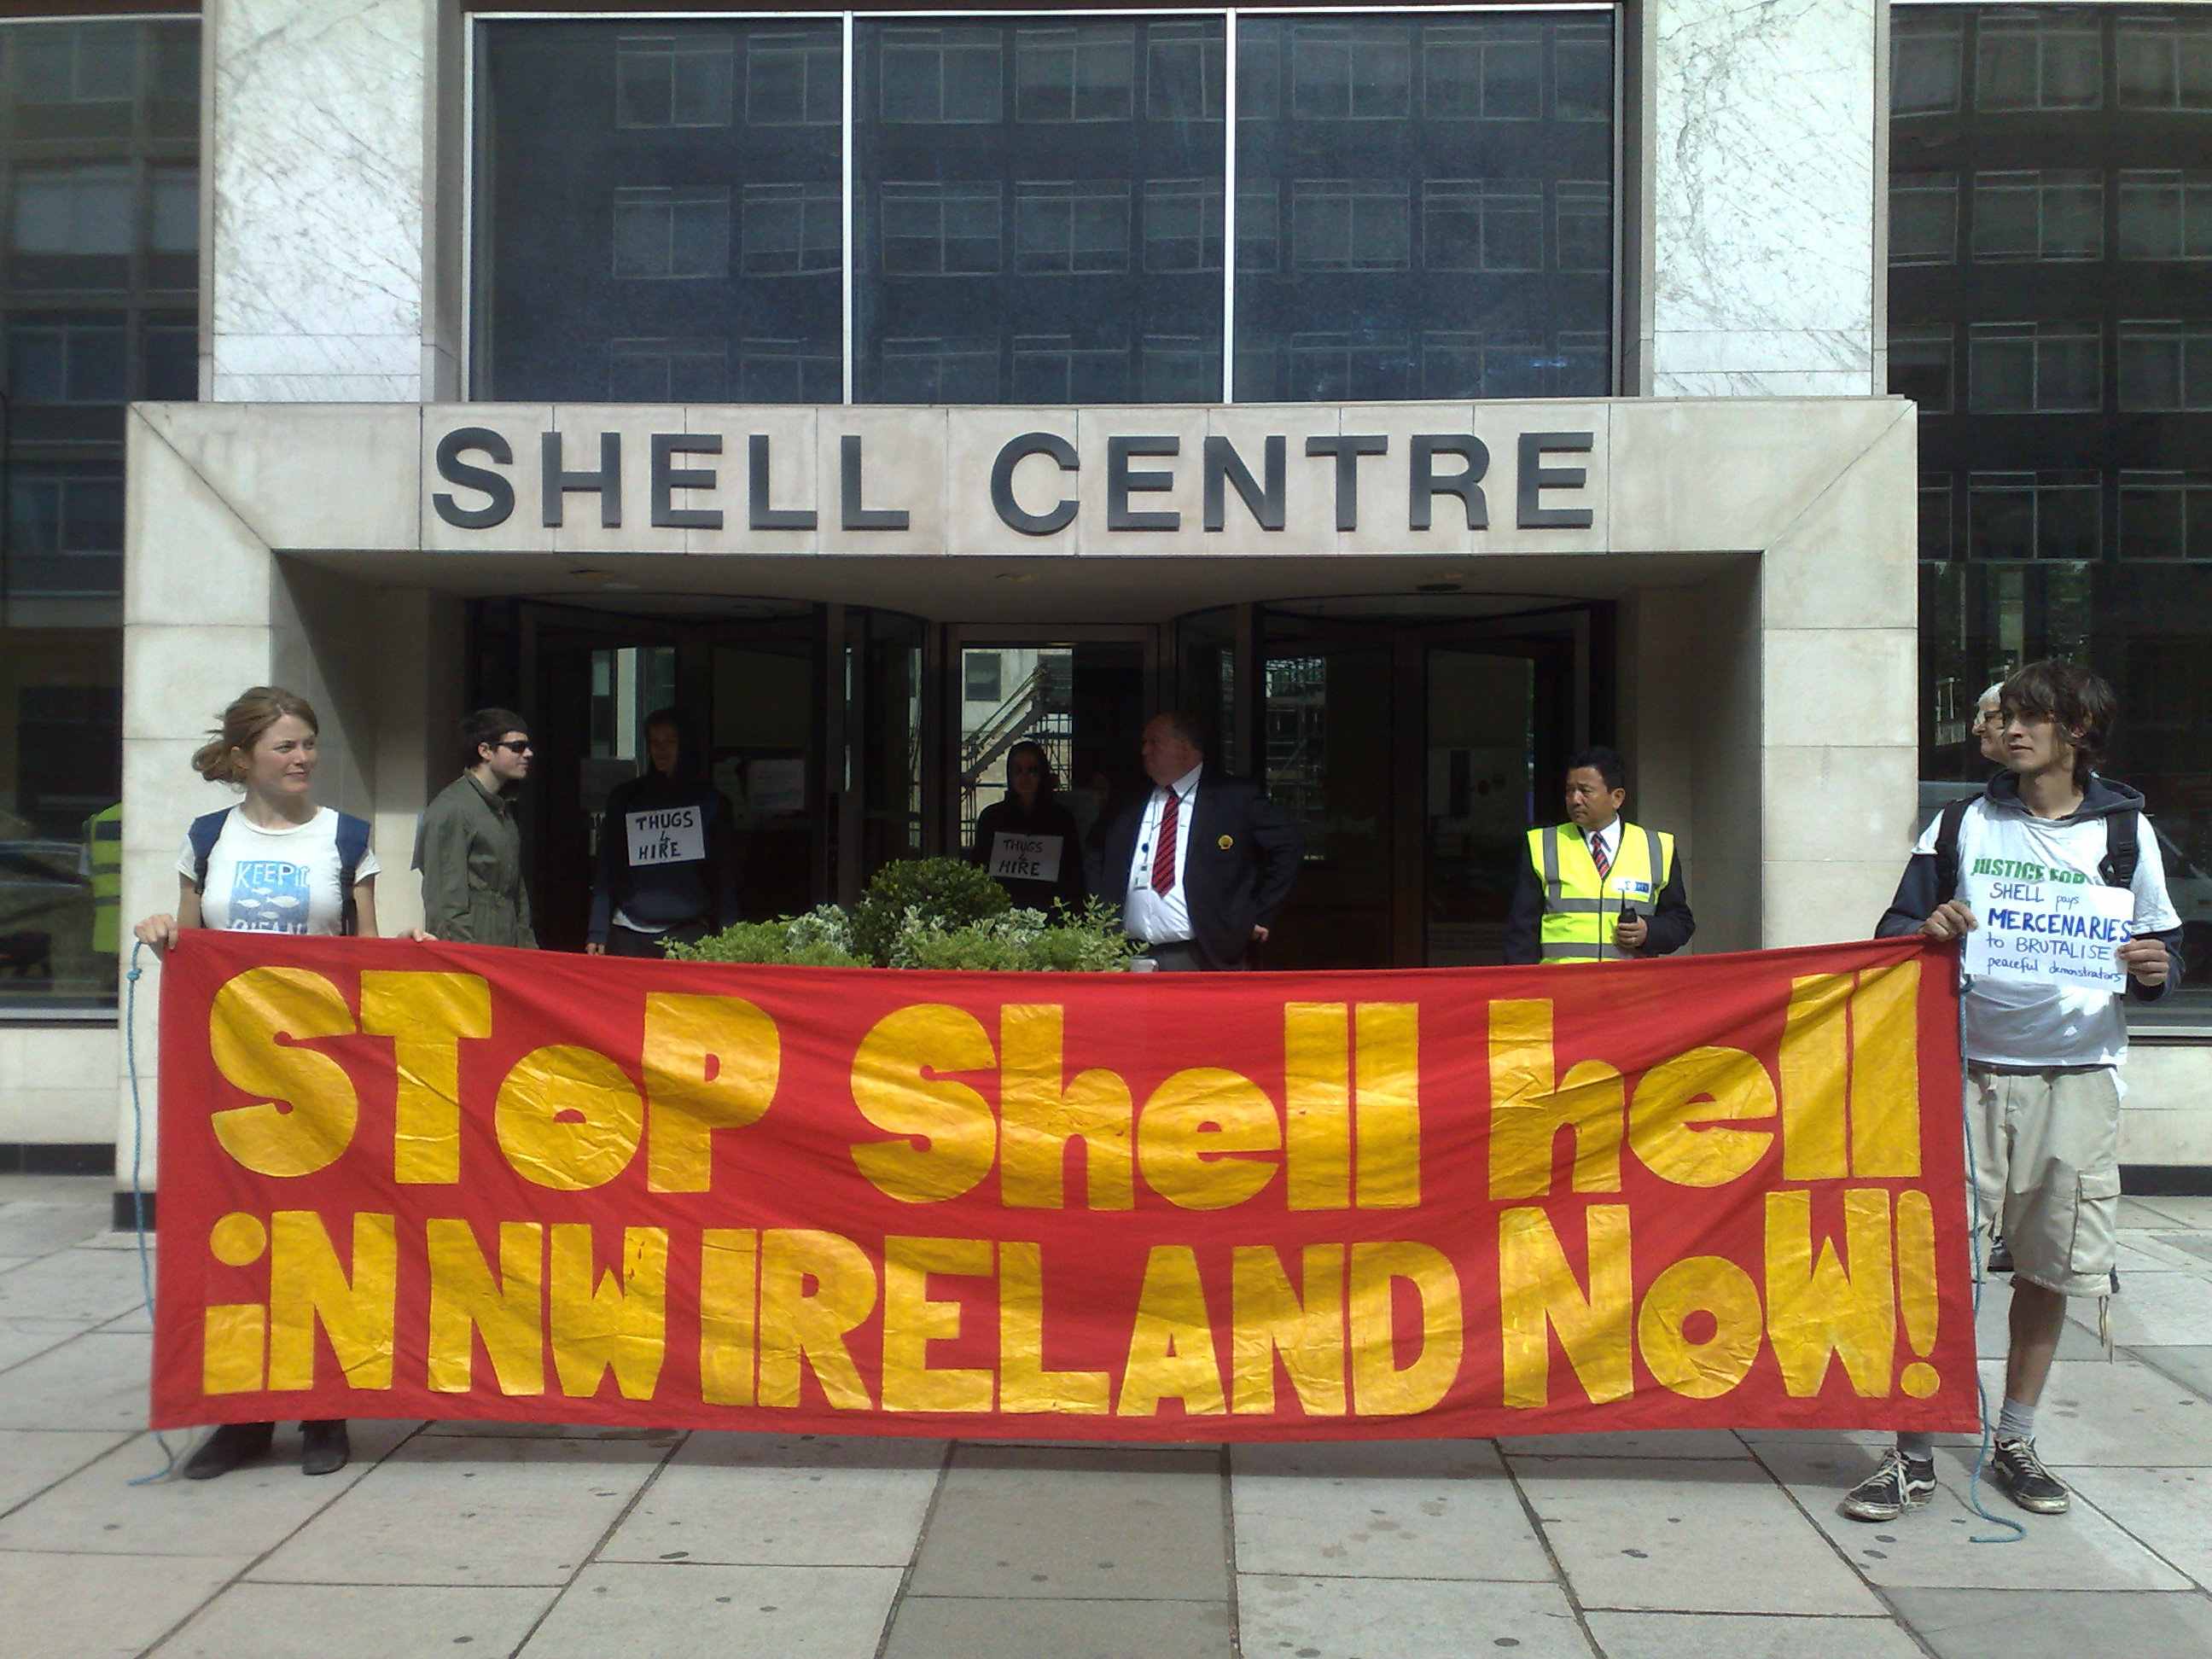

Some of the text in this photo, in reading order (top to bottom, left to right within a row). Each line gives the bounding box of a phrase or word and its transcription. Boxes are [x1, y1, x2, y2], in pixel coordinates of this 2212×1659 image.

[433, 427, 1594, 537] SHELL CENTRE
[636, 811, 693, 830] THUGS
[660, 830, 671, 844] 4
[1004, 839, 1044, 853] THUGS
[639, 841, 681, 860] HIRE
[235, 862, 295, 888] KEEP
[998, 859, 1040, 876] HIRE
[1970, 858, 2046, 880] JUSTICE
[1989, 882, 2081, 912] SHELL pays
[1988, 907, 2134, 943] MERCENARIES
[1987, 931, 2112, 961] to BRUTALISE
[1988, 956, 2124, 982] peaceful demonstrators
[851, 1002, 1422, 1211] Shell
[1488, 960, 1922, 1201] hell
[700, 1227, 1464, 1417] IRELAND
